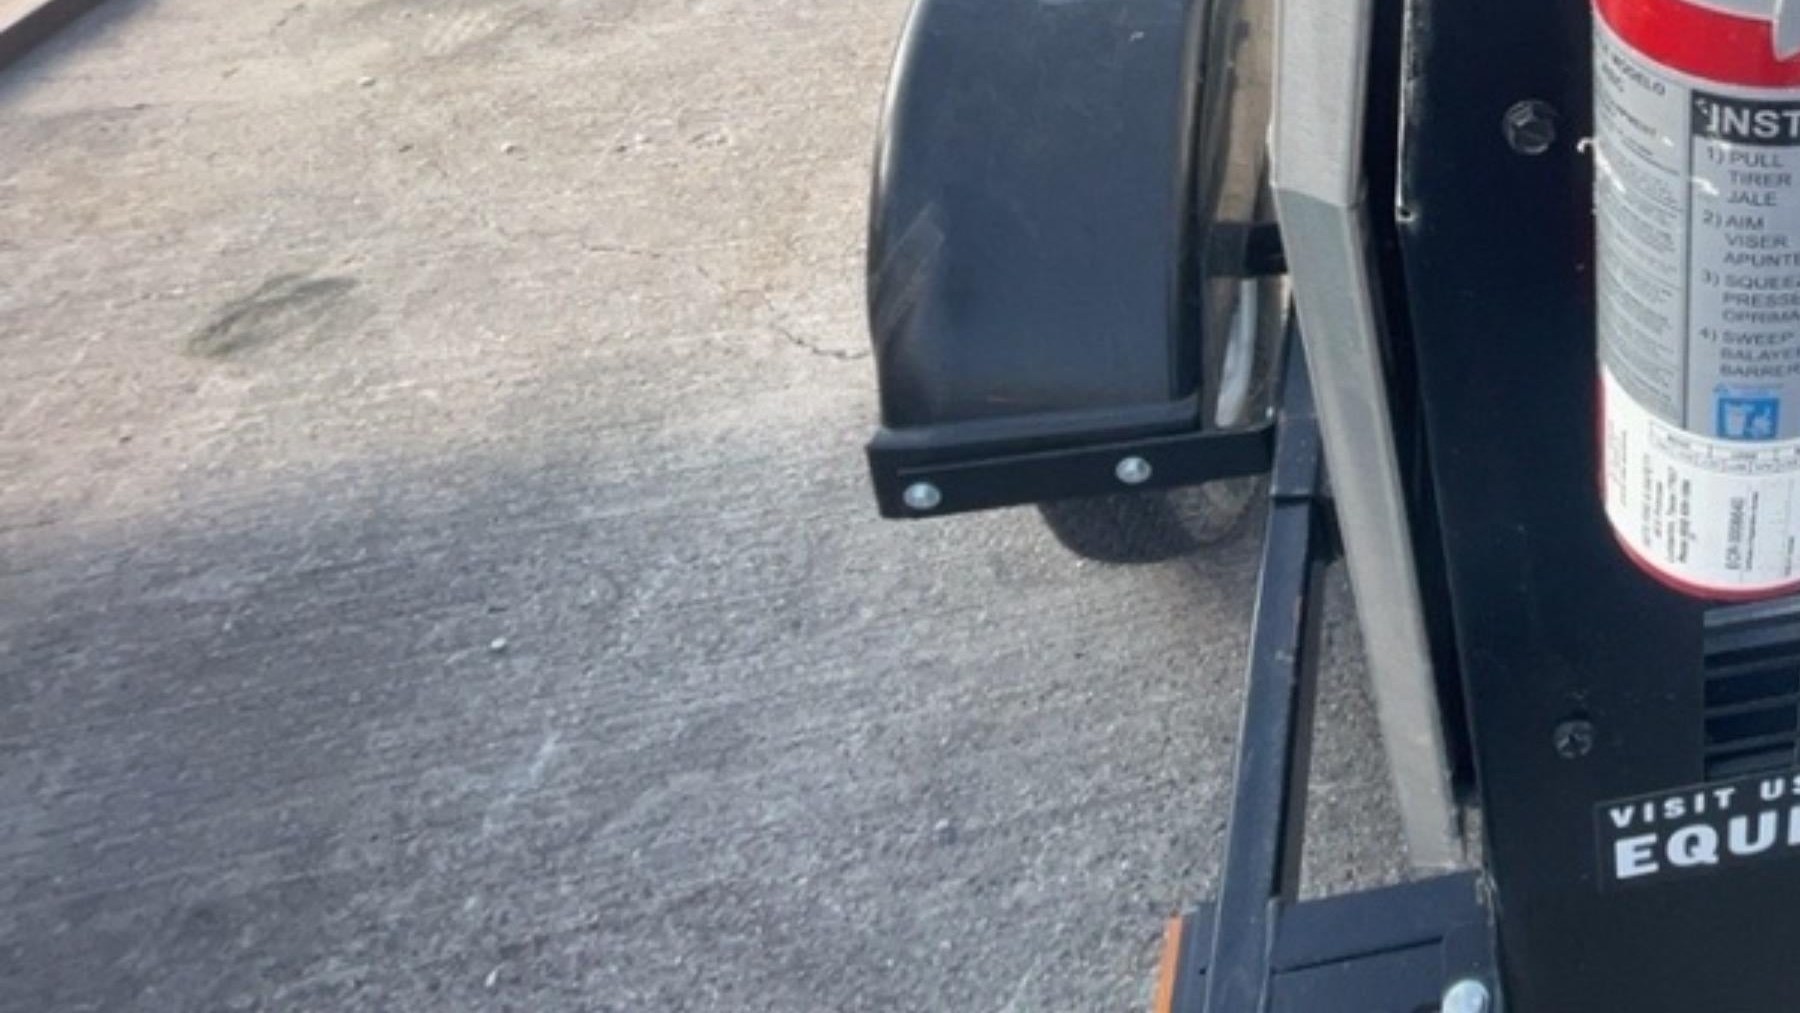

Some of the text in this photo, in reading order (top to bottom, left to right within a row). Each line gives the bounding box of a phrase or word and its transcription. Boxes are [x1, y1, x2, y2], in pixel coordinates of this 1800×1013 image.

[1729, 150, 1785, 168] PULL
[1728, 170, 1793, 187] TIRER
[1727, 190, 1778, 207] JALE
[1724, 215, 1765, 230] AIM
[1724, 233, 1791, 249] VISER
[1721, 308, 1800, 324] OPRIMA
[1721, 330, 1795, 346] SWEEP
[1719, 363, 1800, 378] BARRER
[1608, 787, 1736, 830] VISIT
